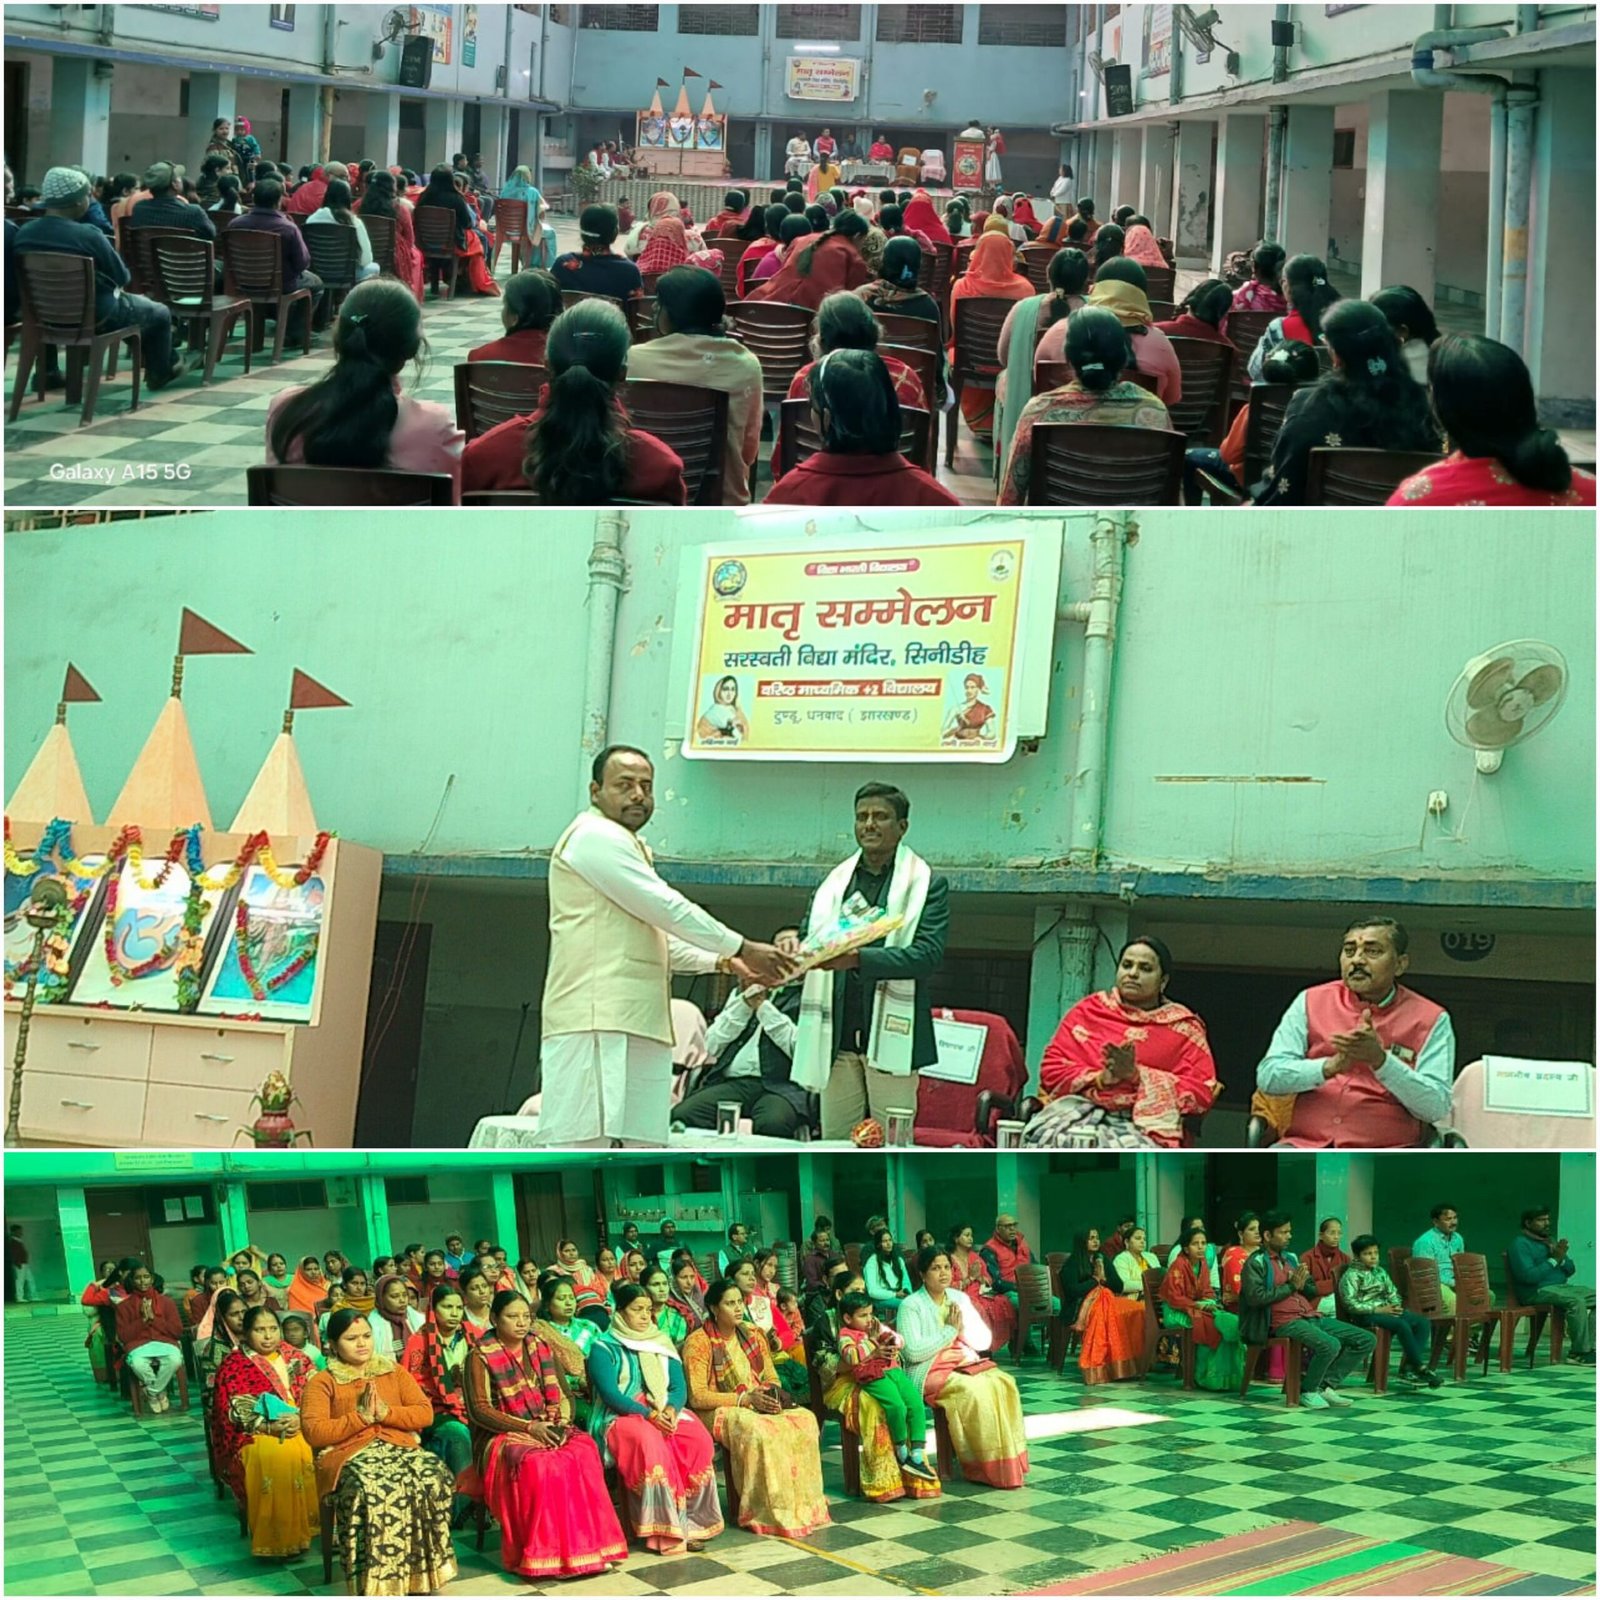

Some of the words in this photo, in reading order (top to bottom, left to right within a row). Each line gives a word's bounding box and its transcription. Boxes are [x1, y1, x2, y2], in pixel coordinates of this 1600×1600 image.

[724, 602, 805, 641] मातृ
[816, 587, 997, 628] सम्मेलन
[724, 644, 791, 667] सरस्वती
[798, 644, 838, 666] विद्या
[905, 640, 988, 665] सिनीडीह
[862, 684, 879, 696] +2
[882, 680, 937, 695] विद्यालय
